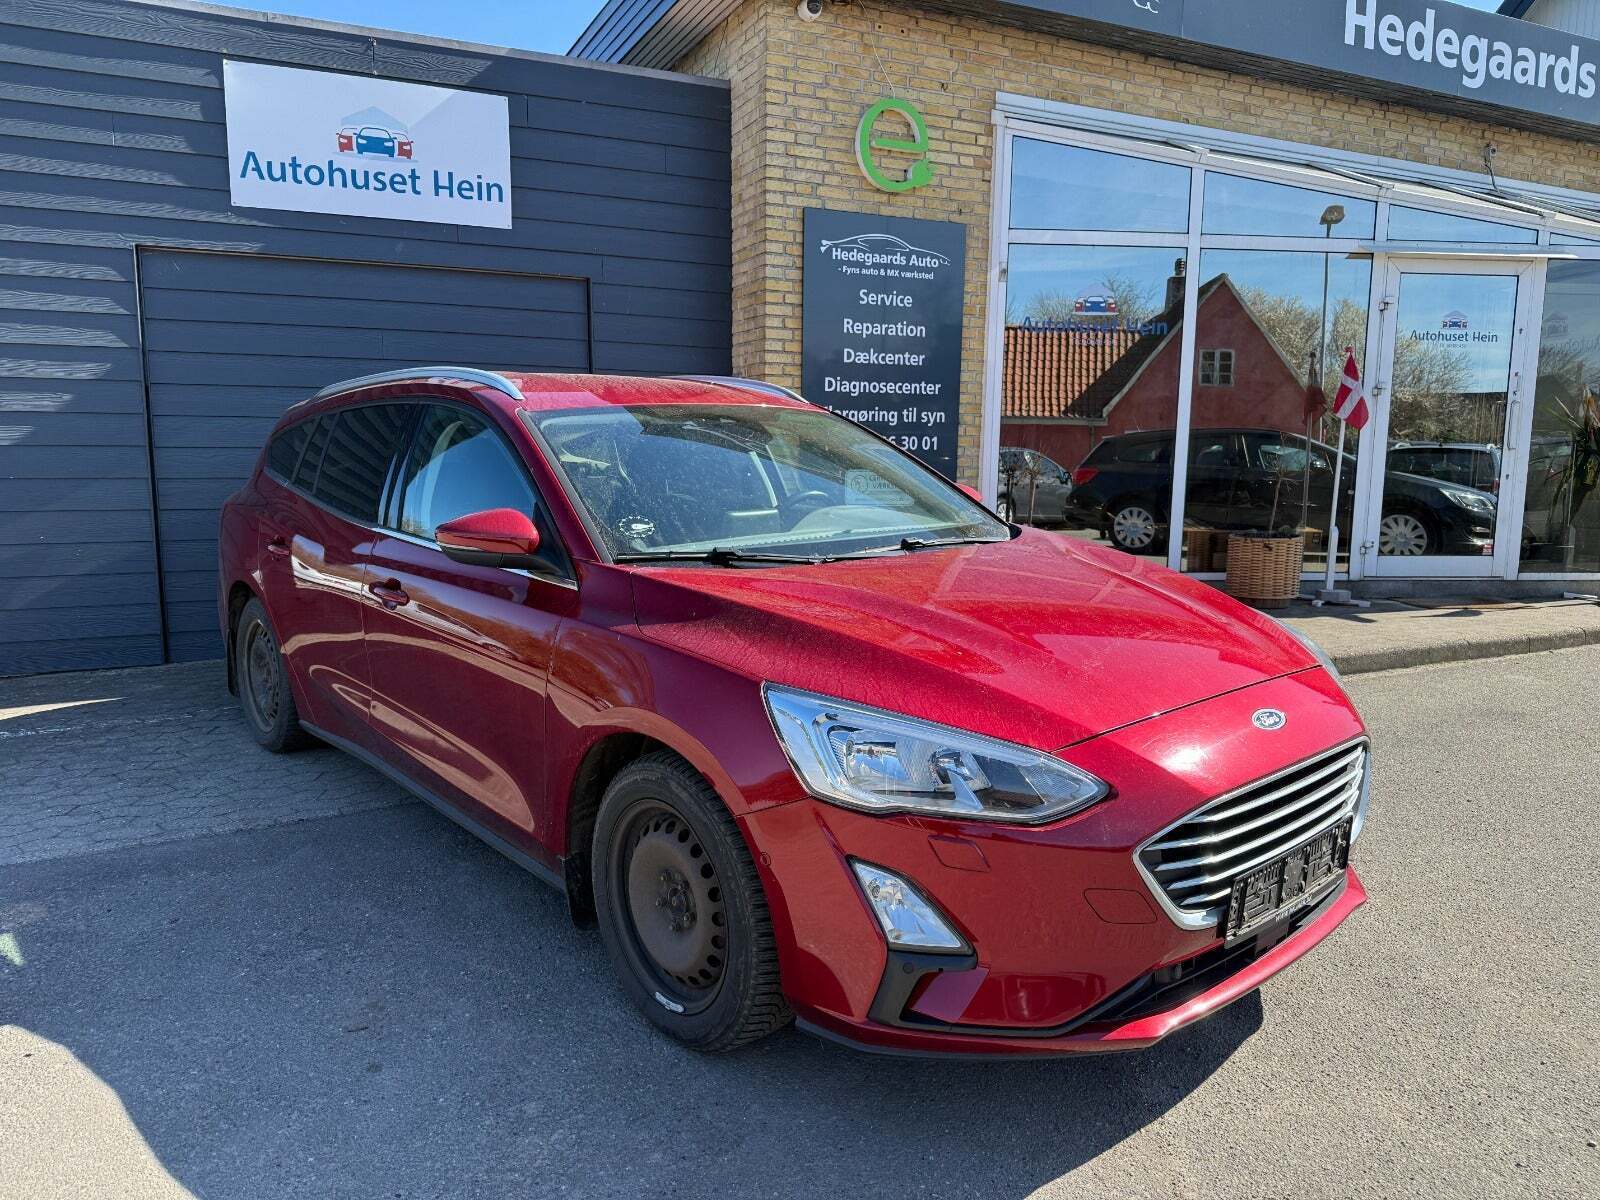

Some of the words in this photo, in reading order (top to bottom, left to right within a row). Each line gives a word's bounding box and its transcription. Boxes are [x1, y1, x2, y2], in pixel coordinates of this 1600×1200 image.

[1344, 0, 1597, 98] Hedegaards
[240, 151, 421, 195] Autohuset
[434, 170, 504, 202] Hein
[832, 248, 907, 266] Hedegaards
[909, 254, 939, 268] Auto
[842, 266, 860, 275] Fyns
[887, 269, 899, 278] MX
[901, 271, 934, 280] værksted
[859, 289, 913, 308] Service
[843, 318, 926, 338] Reparation
[1021, 317, 1119, 333] Autohuset
[1127, 318, 1168, 335] Hein
[1410, 330, 1468, 342] Autohuset
[1472, 332, 1498, 343] Hein
[843, 348, 925, 366] Dækcenter
[824, 376, 942, 396] Diagnosecenter
[902, 407, 917, 423] til
[921, 412, 946, 427] syn
[901, 436, 918, 451] 30
[922, 436, 938, 451] 01
